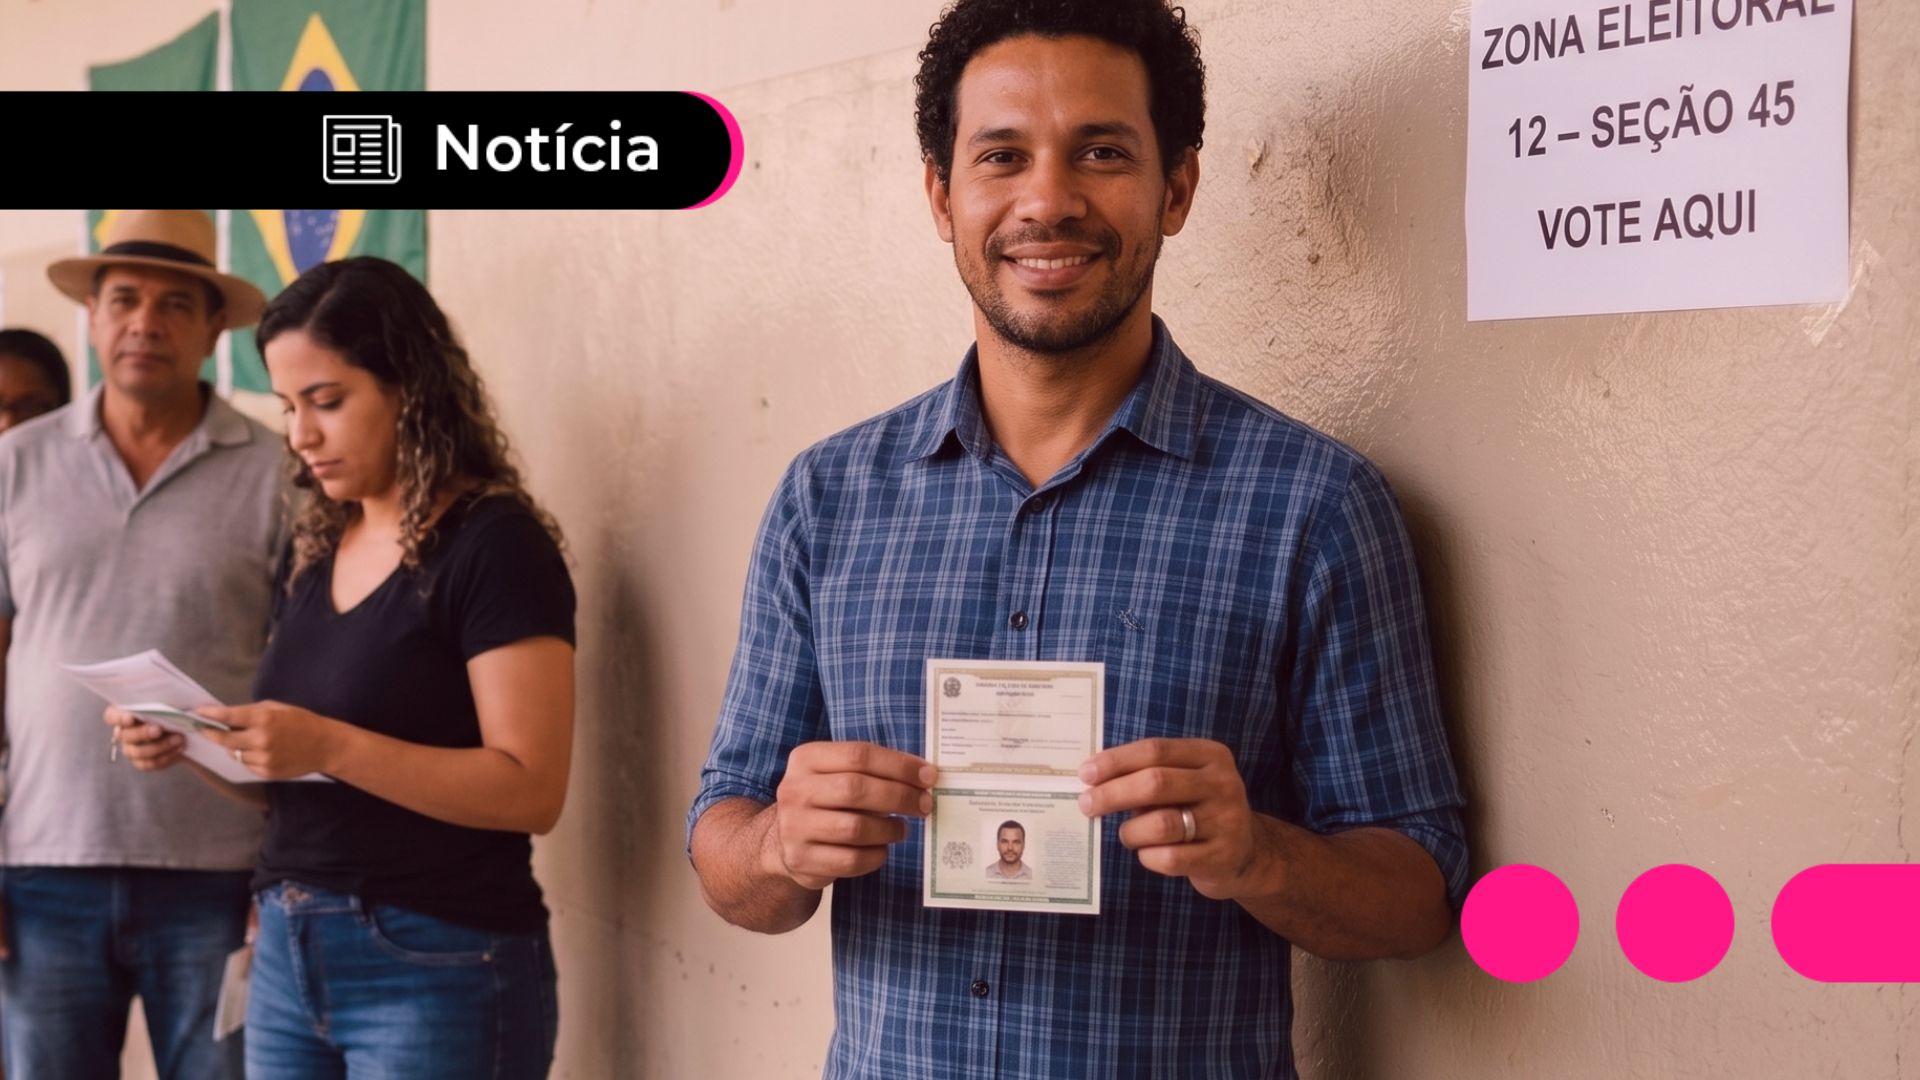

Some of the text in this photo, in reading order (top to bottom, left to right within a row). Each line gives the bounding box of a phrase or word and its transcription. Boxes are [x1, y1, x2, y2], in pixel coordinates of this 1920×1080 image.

[1481, 14, 1585, 70] ZONA
[1508, 114, 1547, 158] 12
[1591, 83, 1734, 153] SEÇÃO
[1747, 79, 1796, 128] 45
[1537, 188, 1756, 250] VOTE AQUI
